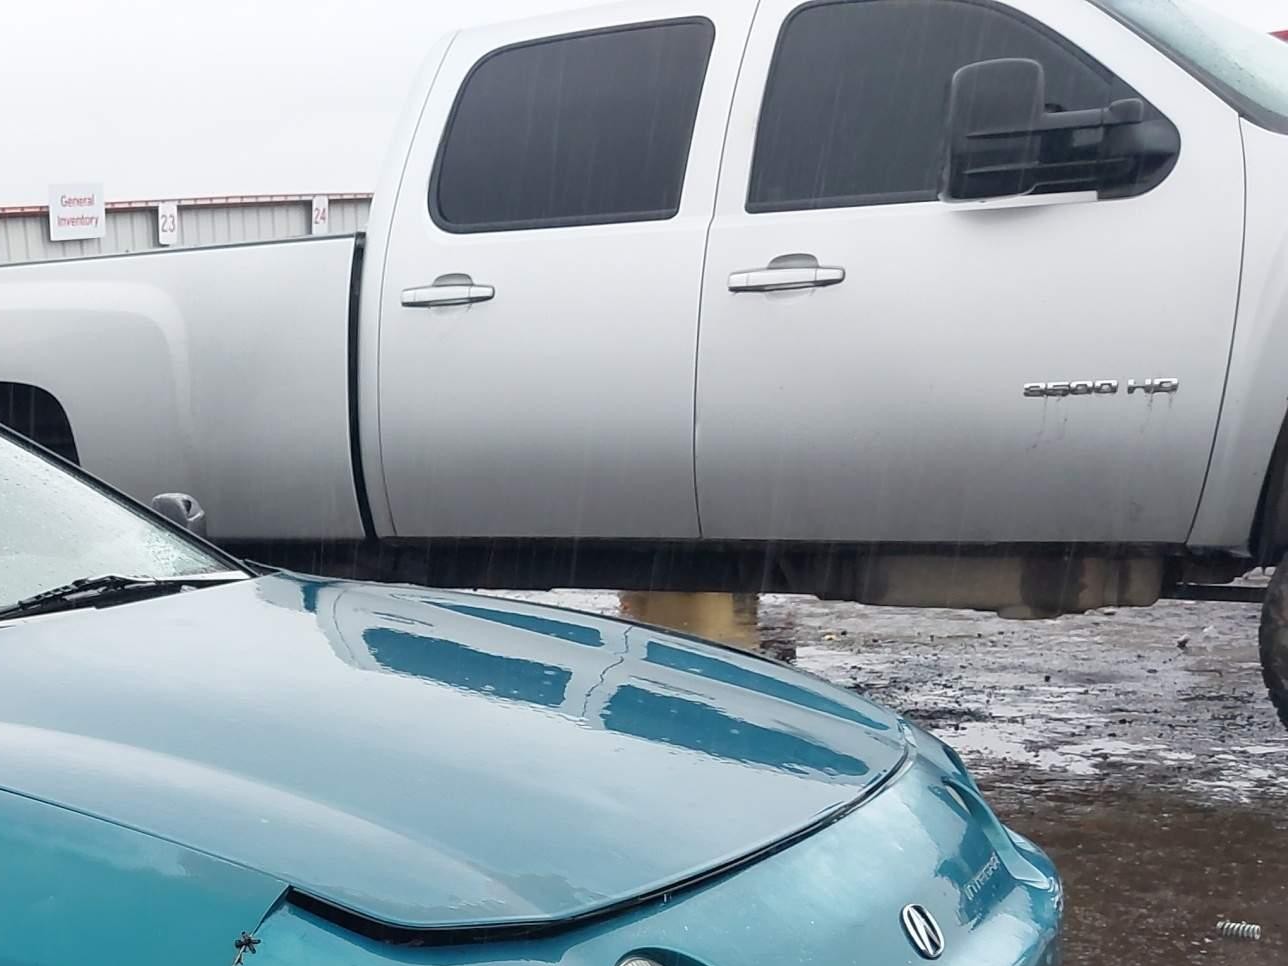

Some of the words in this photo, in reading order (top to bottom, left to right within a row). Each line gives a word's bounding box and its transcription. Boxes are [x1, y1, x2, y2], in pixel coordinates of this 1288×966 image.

[60, 193, 95, 207] General
[57, 214, 99, 227] Inventory
[161, 214, 176, 233] 23
[314, 207, 326, 224] 24
[1127, 377, 1179, 395] HD
